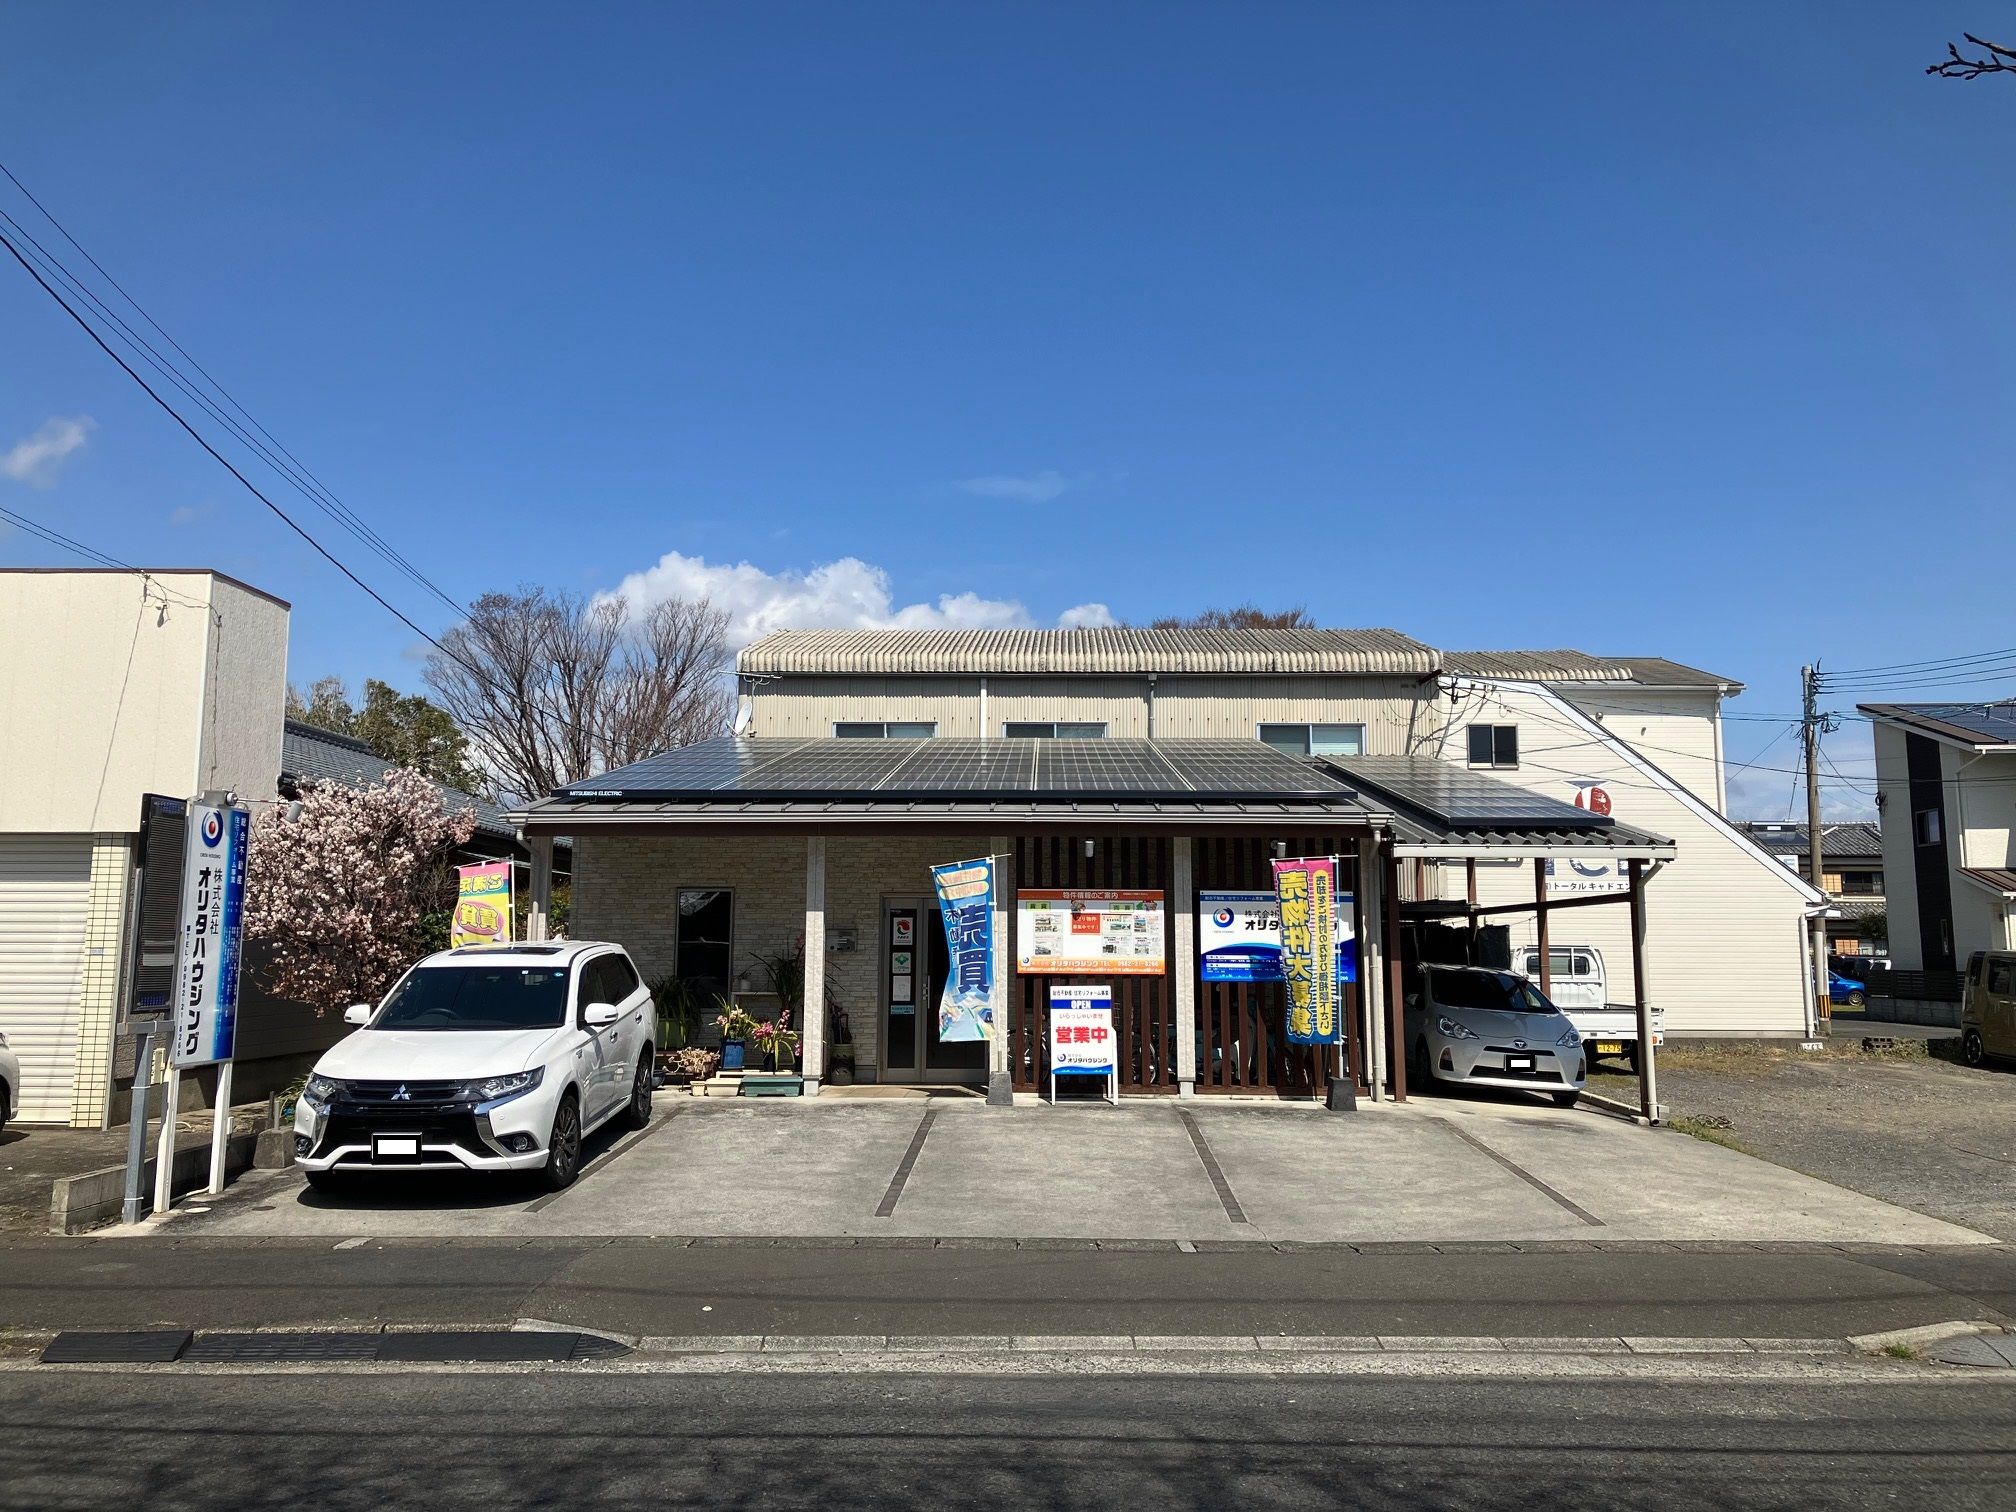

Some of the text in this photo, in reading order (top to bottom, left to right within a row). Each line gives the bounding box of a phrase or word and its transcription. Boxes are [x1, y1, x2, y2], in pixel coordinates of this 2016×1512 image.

[210, 867, 223, 935] 株式会社
[1062, 891, 1119, 899] 物件情報のご案内
[1245, 910, 1278, 918] 株式会社
[186, 867, 211, 1055] オリタハウジング
[1071, 1000, 1091, 1009] OPEN
[1055, 1026, 1108, 1043] 営業中
